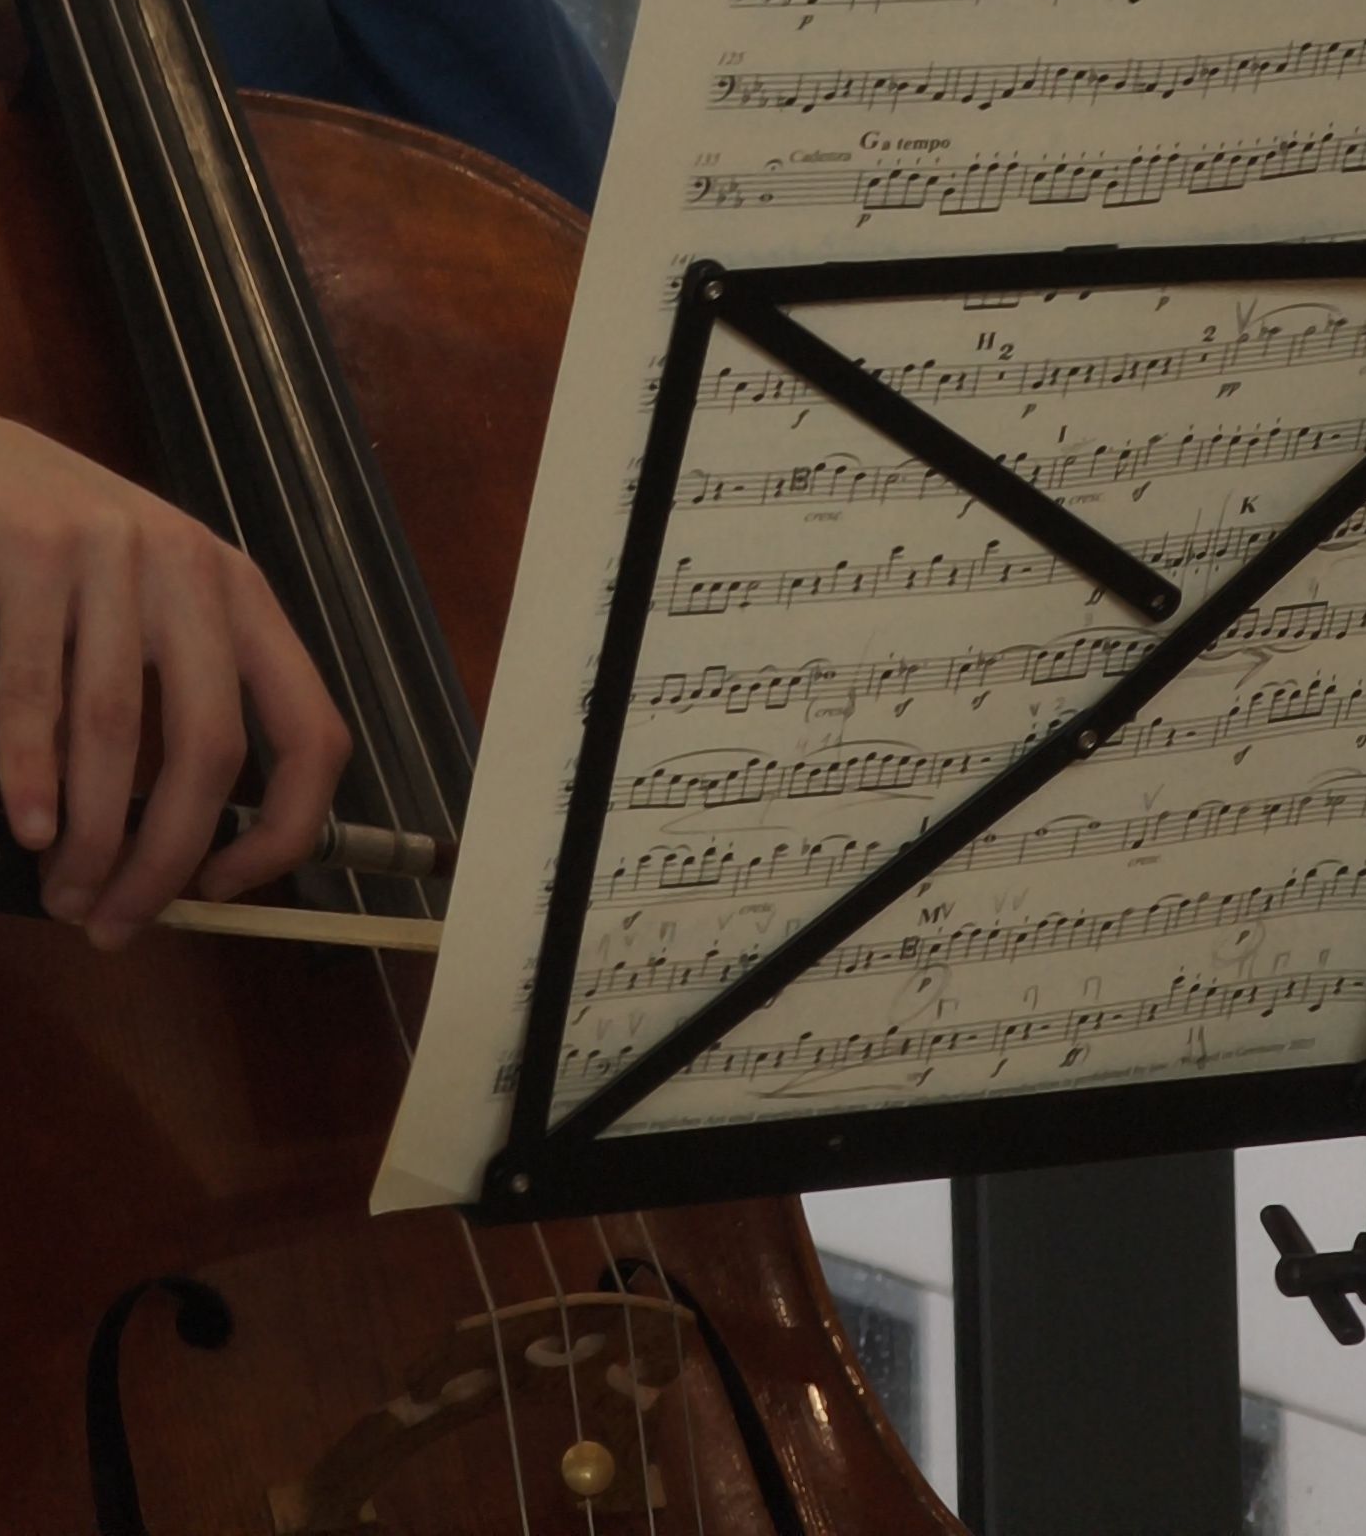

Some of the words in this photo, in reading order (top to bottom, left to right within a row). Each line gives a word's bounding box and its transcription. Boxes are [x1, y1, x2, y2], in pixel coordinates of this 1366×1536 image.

[859, 131, 880, 150] G
[897, 137, 951, 154] tempo
[977, 332, 998, 351] H
[1203, 325, 1217, 342] 2
[998, 344, 1015, 361] 2
[1240, 495, 1260, 516] K
